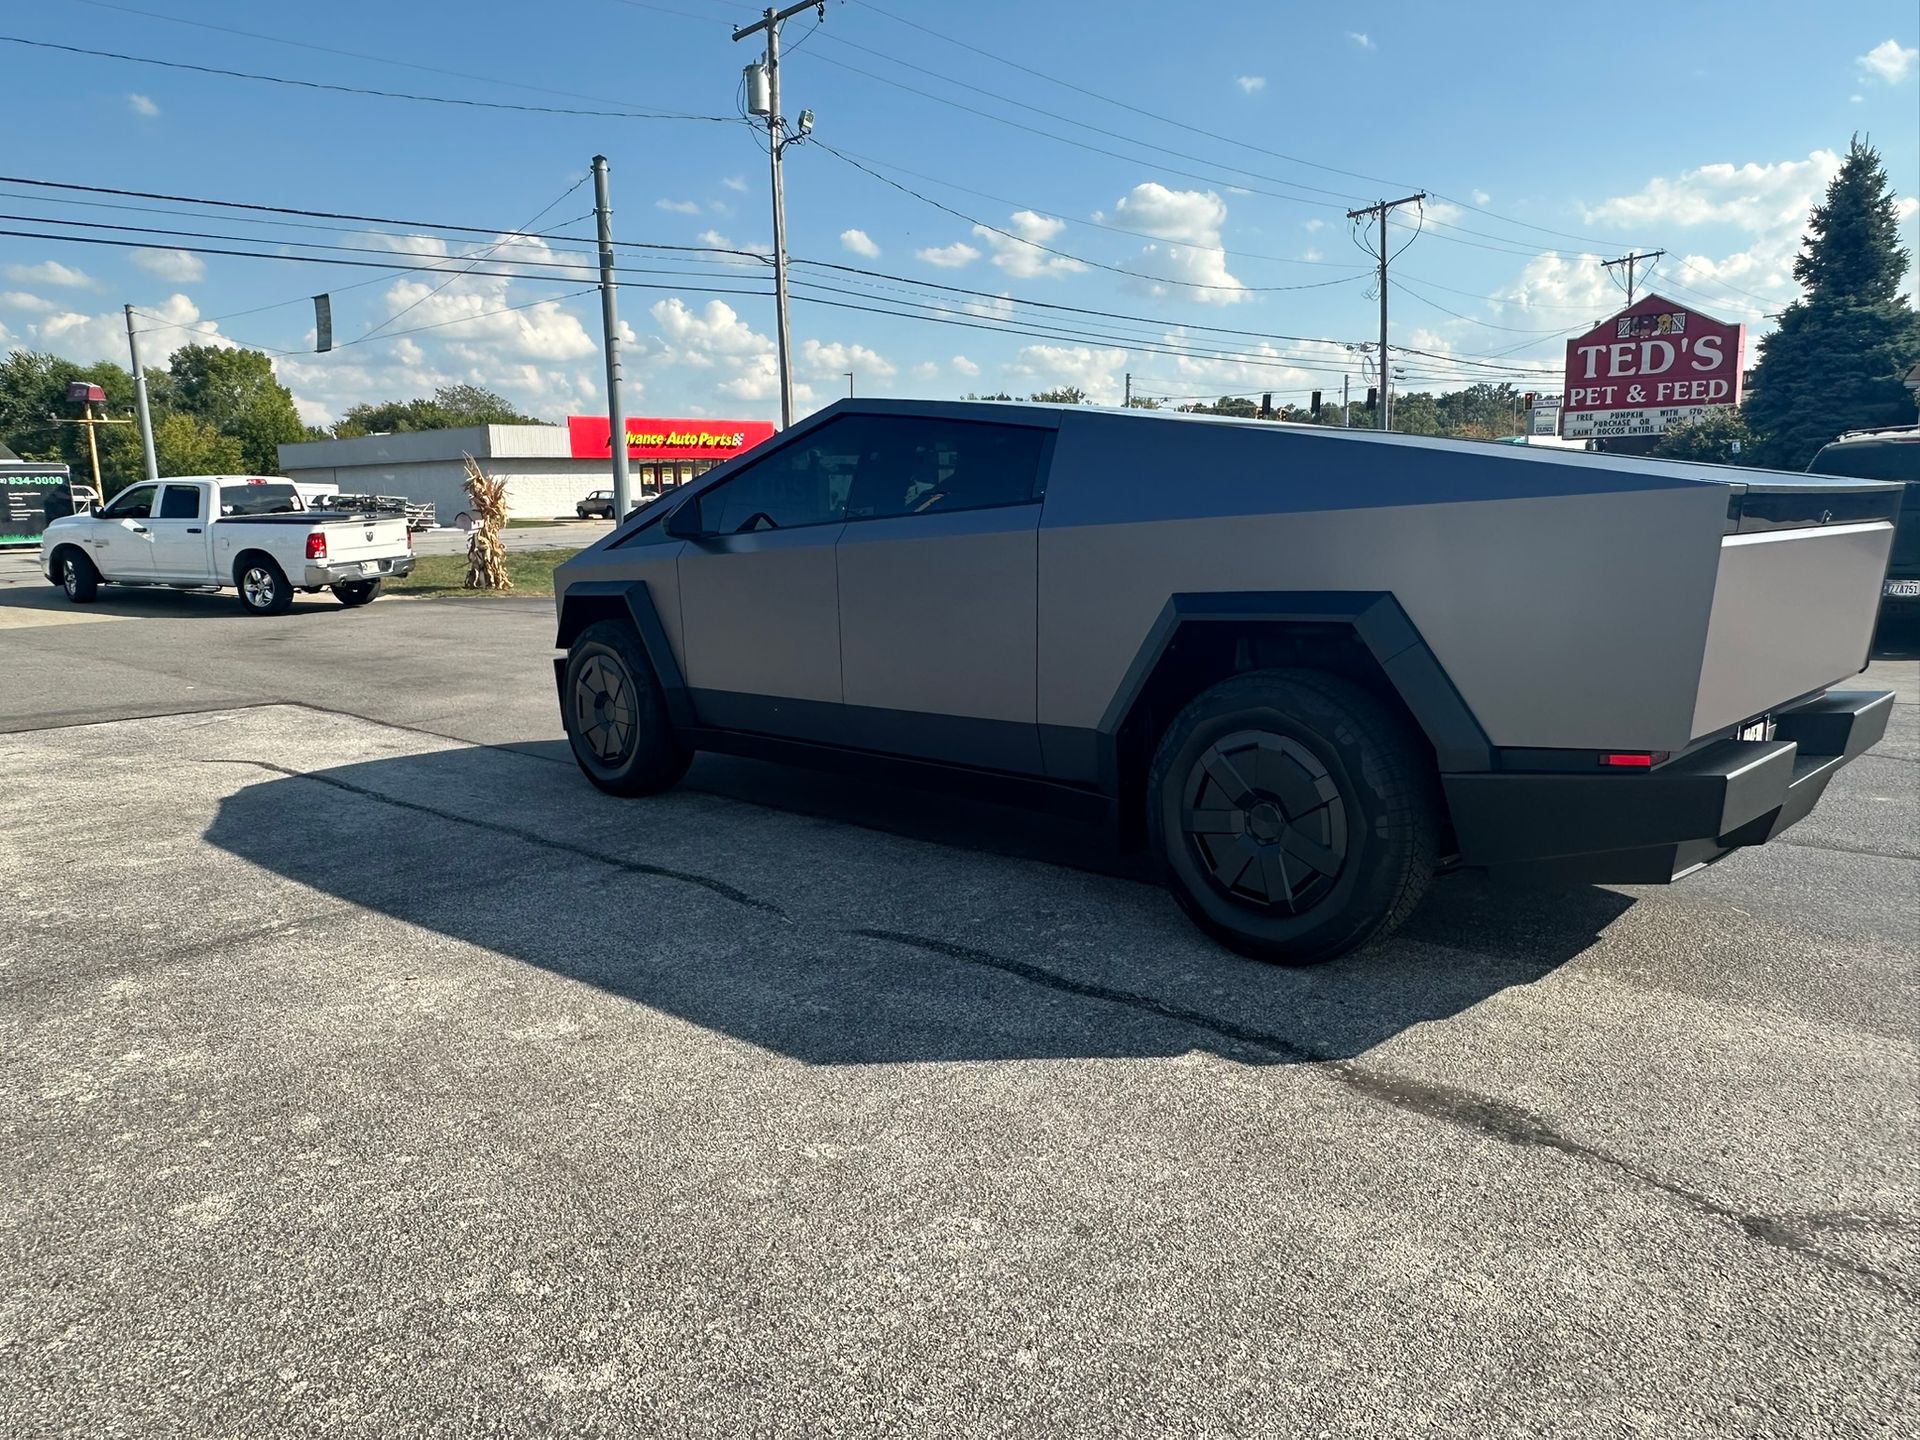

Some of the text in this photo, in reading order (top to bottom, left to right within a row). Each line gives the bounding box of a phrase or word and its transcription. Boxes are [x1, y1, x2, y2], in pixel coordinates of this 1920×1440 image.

[1577, 335, 1724, 379] TED'S
[1570, 379, 1729, 407] PET & FEED
[1576, 413, 1594, 422] FREE
[1610, 411, 1644, 420] PUMPKIN
[1660, 409, 1679, 417] WITH
[1593, 418, 1631, 428] PURCHASE
[1572, 428, 1593, 437] SAINT
[1597, 427, 1625, 436] ROCCOS
[1628, 425, 1655, 434] ENTIRE
[624, 431, 733, 447] dvance Auto Parts
[8, 476, 63, 485] 934-0000
